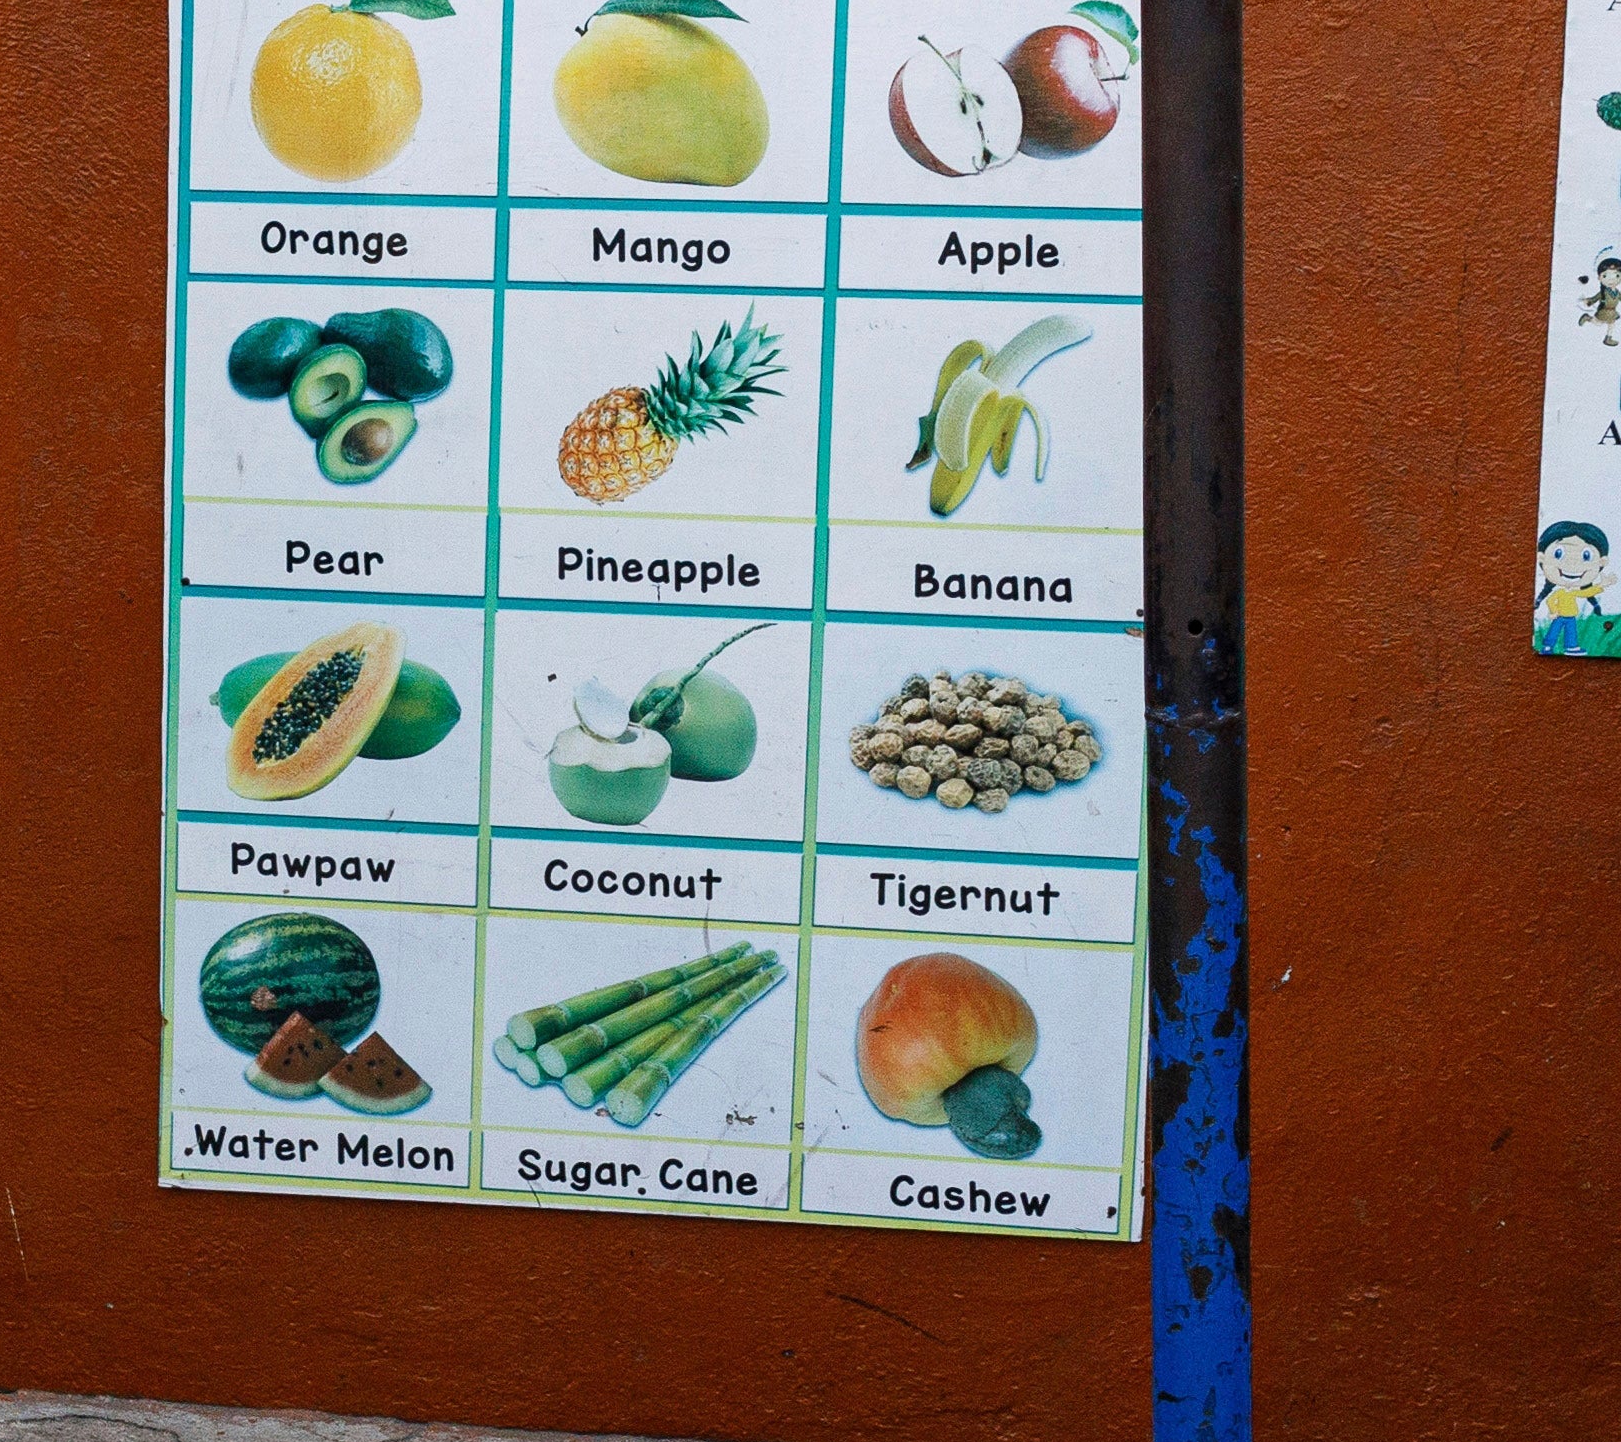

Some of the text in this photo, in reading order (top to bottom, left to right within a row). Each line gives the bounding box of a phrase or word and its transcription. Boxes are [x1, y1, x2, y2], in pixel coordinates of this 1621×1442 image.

[259, 220, 409, 262] Orange
[592, 228, 732, 272] Mango
[937, 231, 1061, 274] Apple
[285, 540, 384, 578] Pear
[557, 547, 761, 591] Pineapple
[914, 565, 1074, 604] Banana
[230, 842, 395, 886] Pawpaw
[543, 858, 722, 902] Coconut
[871, 872, 1061, 916] Tigernut
[195, 1125, 455, 1173] Water Melon
[518, 1150, 759, 1197] Sugar Cane
[890, 1175, 1052, 1217] Cashew
